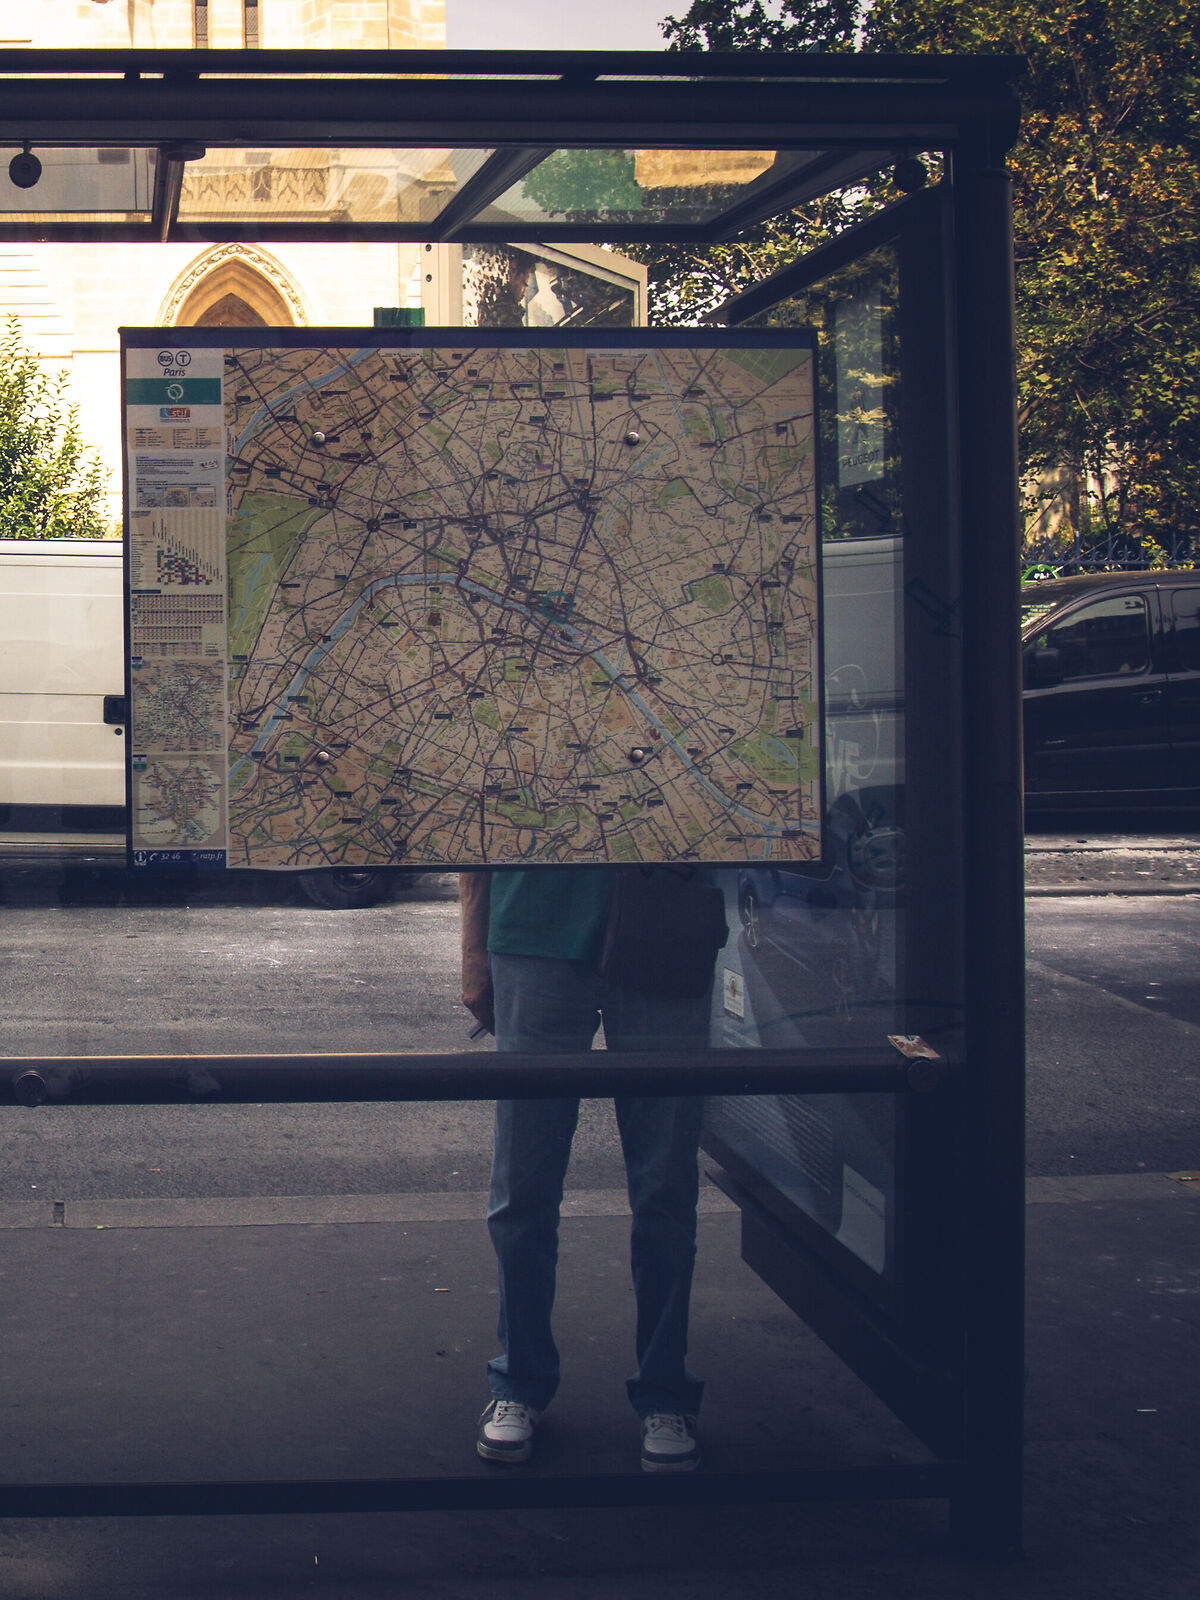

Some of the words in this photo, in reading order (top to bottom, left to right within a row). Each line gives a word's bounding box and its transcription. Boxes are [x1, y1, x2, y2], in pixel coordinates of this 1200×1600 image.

[180, 354, 187, 363] T
[163, 367, 186, 377] Paris
[160, 853, 170, 861] 32
[170, 852, 181, 861] 46
[199, 851, 223, 862] ratp.fr
